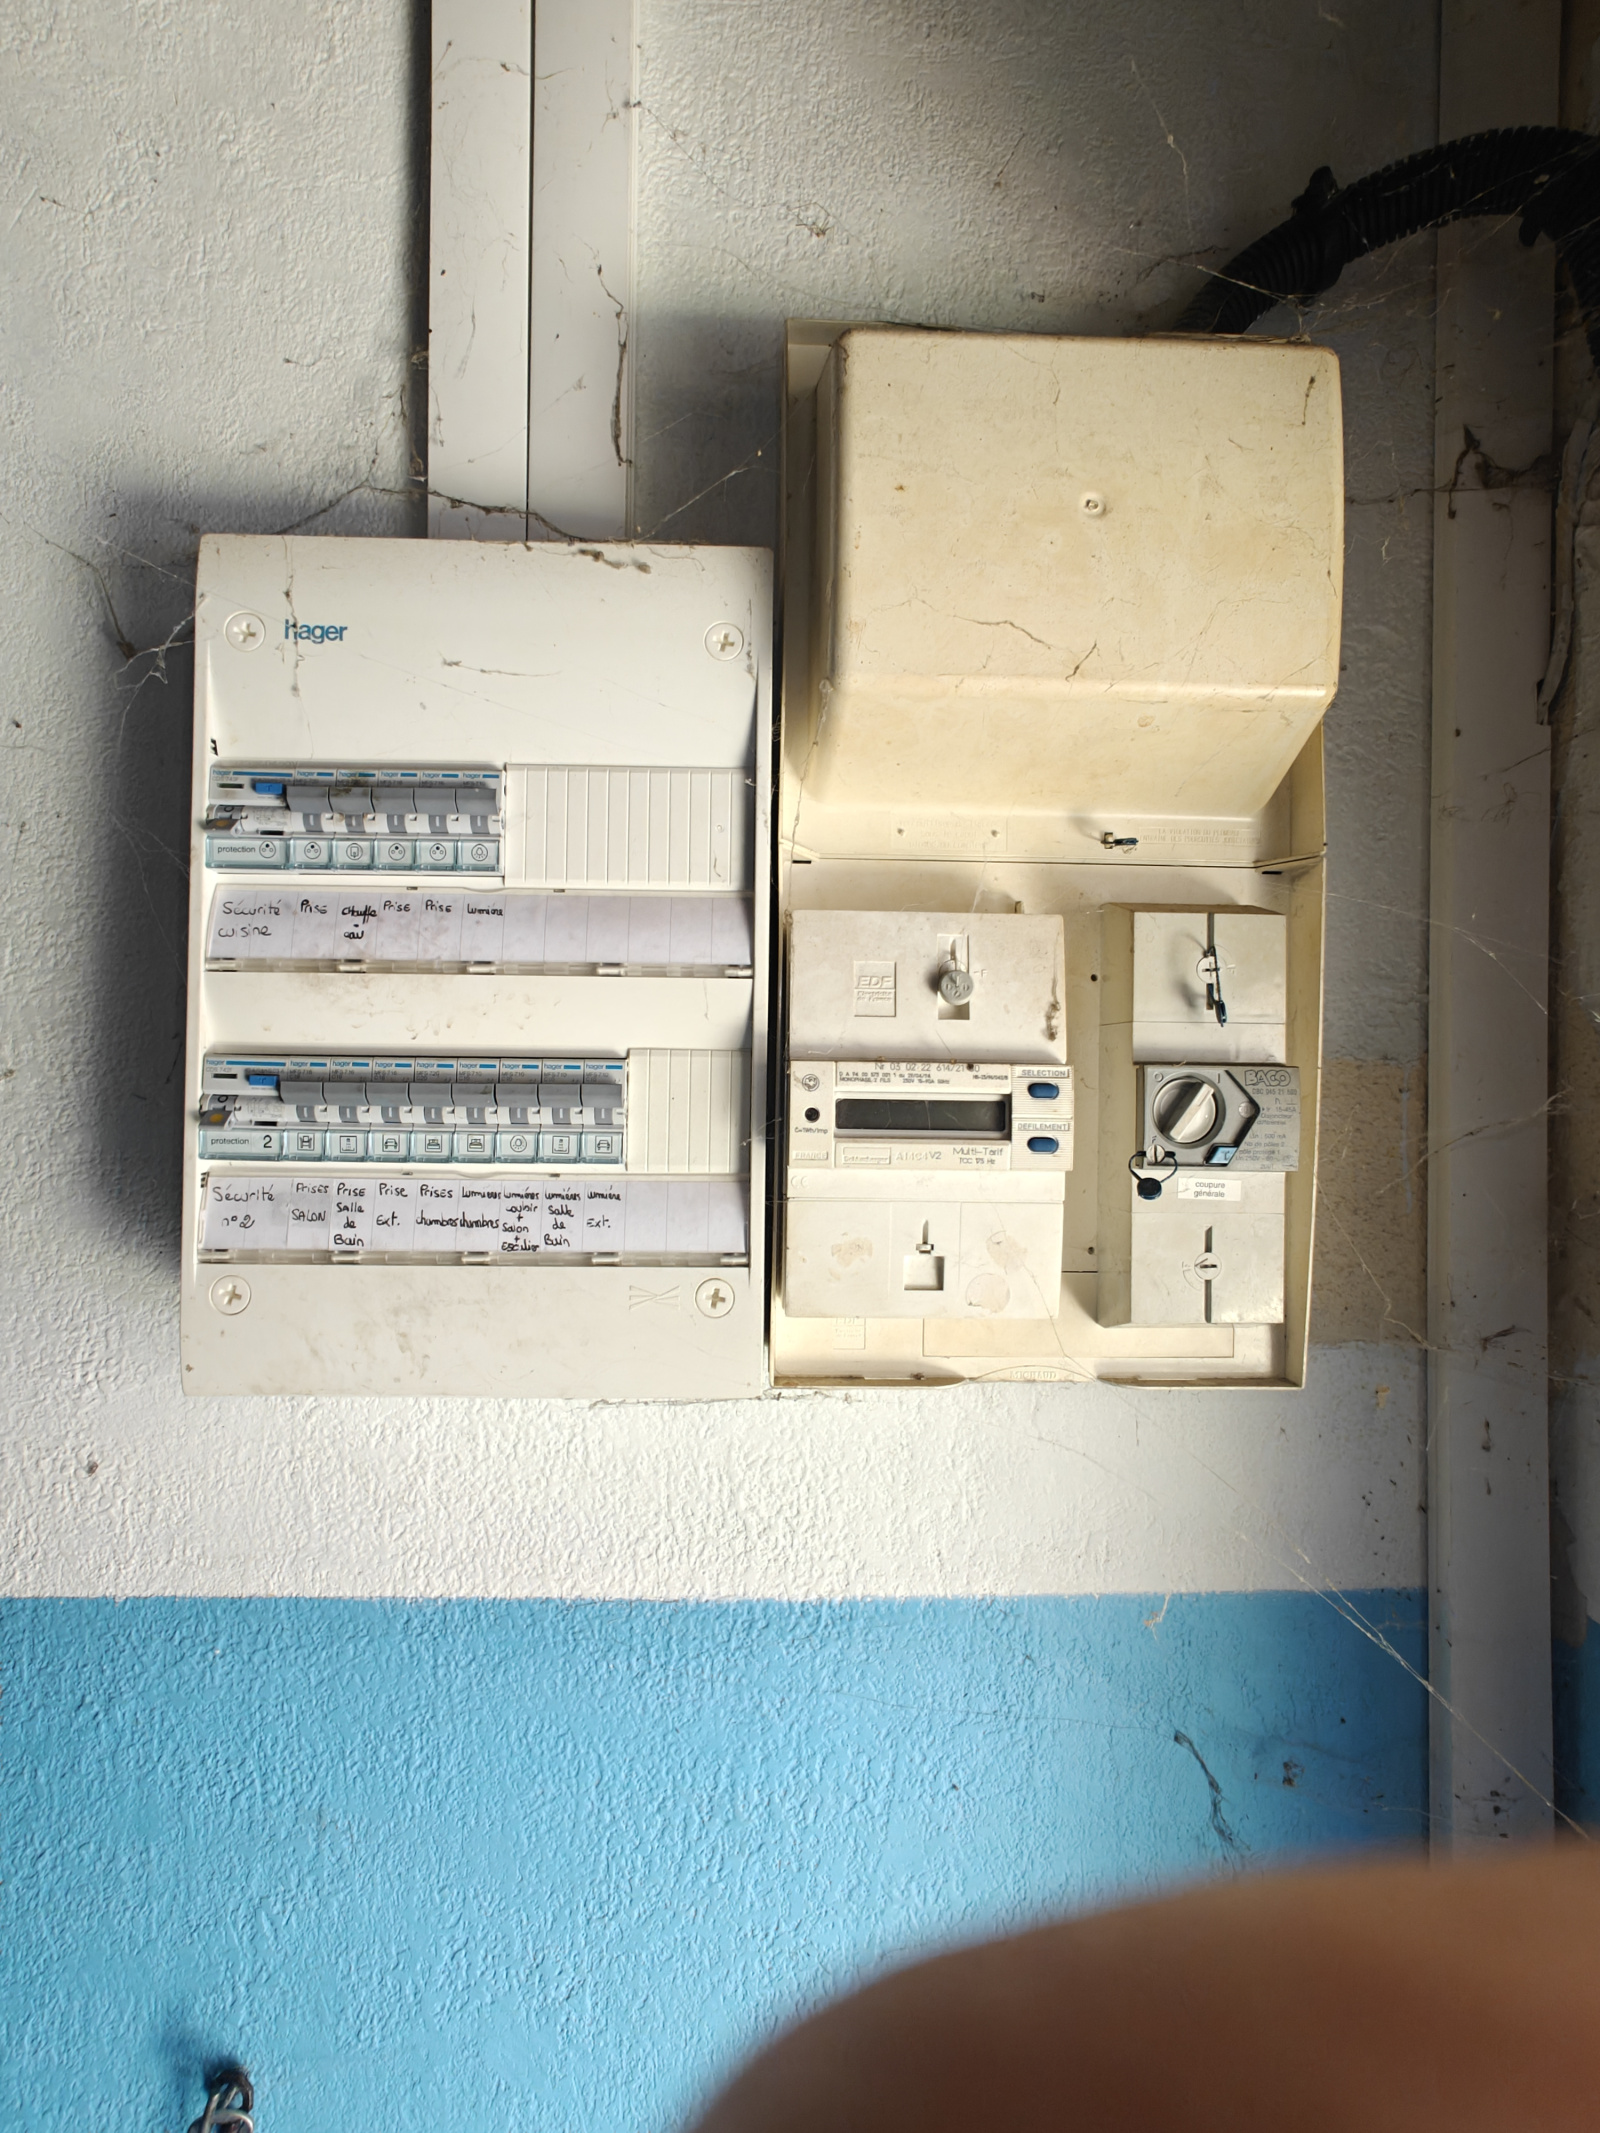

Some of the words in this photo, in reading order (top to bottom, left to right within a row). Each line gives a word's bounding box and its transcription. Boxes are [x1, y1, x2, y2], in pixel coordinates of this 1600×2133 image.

[284, 619, 348, 644] hager
[212, 769, 232, 777] hager
[296, 770, 316, 778] hager
[338, 770, 358, 778] hager
[381, 771, 400, 779] hager
[422, 771, 442, 779] hager
[463, 772, 482, 780] hager
[217, 846, 256, 854] protection
[222, 899, 282, 915] Sécurité
[856, 975, 893, 988] EDF
[206, 1059, 225, 1067] hager
[290, 1060, 309, 1068] hager
[332, 1060, 351, 1068] hager
[416, 1061, 435, 1069] hager
[502, 1062, 521, 1070] hager
[1021, 1069, 1066, 1077] SELECTION
[1244, 1069, 1291, 1087] BACO
[1017, 1122, 1067, 1131] DEFILEMENT
[211, 1137, 249, 1145] protection
[263, 1134, 273, 1148] 2
[952, 1147, 1004, 1157] Multi-Tarif
[1195, 1181, 1226, 1189] coupure
[212, 1184, 275, 1201] Sécurité
[379, 1183, 408, 1197] Prise
[1193, 1189, 1225, 1198] générale
[336, 1202, 365, 1214] Salle
[516, 1213, 524, 1222] +
[343, 1216, 357, 1229] de
[552, 1217, 567, 1230] de
[333, 1233, 364, 1247] Bain
[514, 1235, 521, 1243] +
[543, 1233, 571, 1248] Bain
